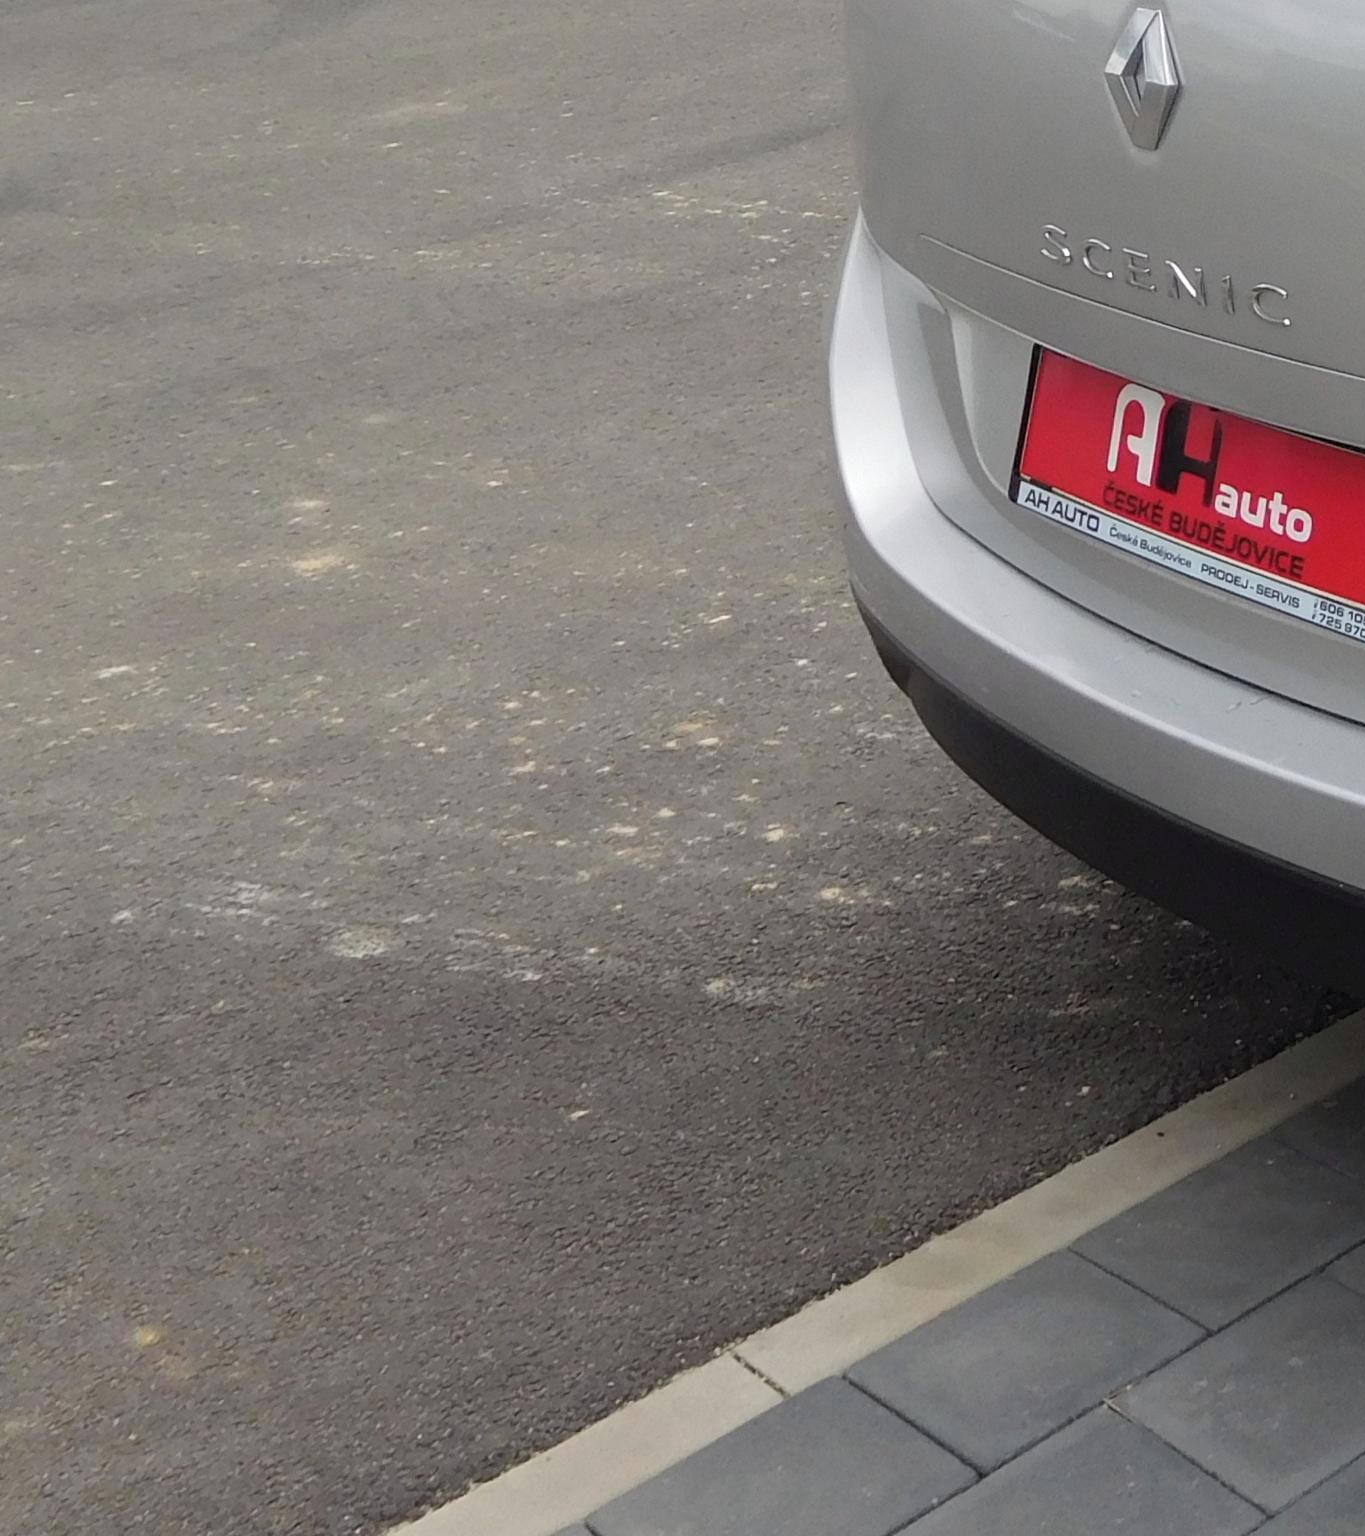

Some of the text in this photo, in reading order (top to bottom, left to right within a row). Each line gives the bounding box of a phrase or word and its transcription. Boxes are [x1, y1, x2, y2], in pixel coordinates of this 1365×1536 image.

[1041, 224, 1291, 326] SCENIC
[1024, 489, 1100, 533] AH AUTO
[1103, 479, 1305, 579] ČESKÉ BUDĚJOVICE
[1139, 539, 1192, 569] Budějovice
[1200, 563, 1249, 590] PRODEJ
[1255, 584, 1300, 609] SERVIS
[1319, 600, 1344, 618] 606
[1319, 612, 1342, 630] 725
